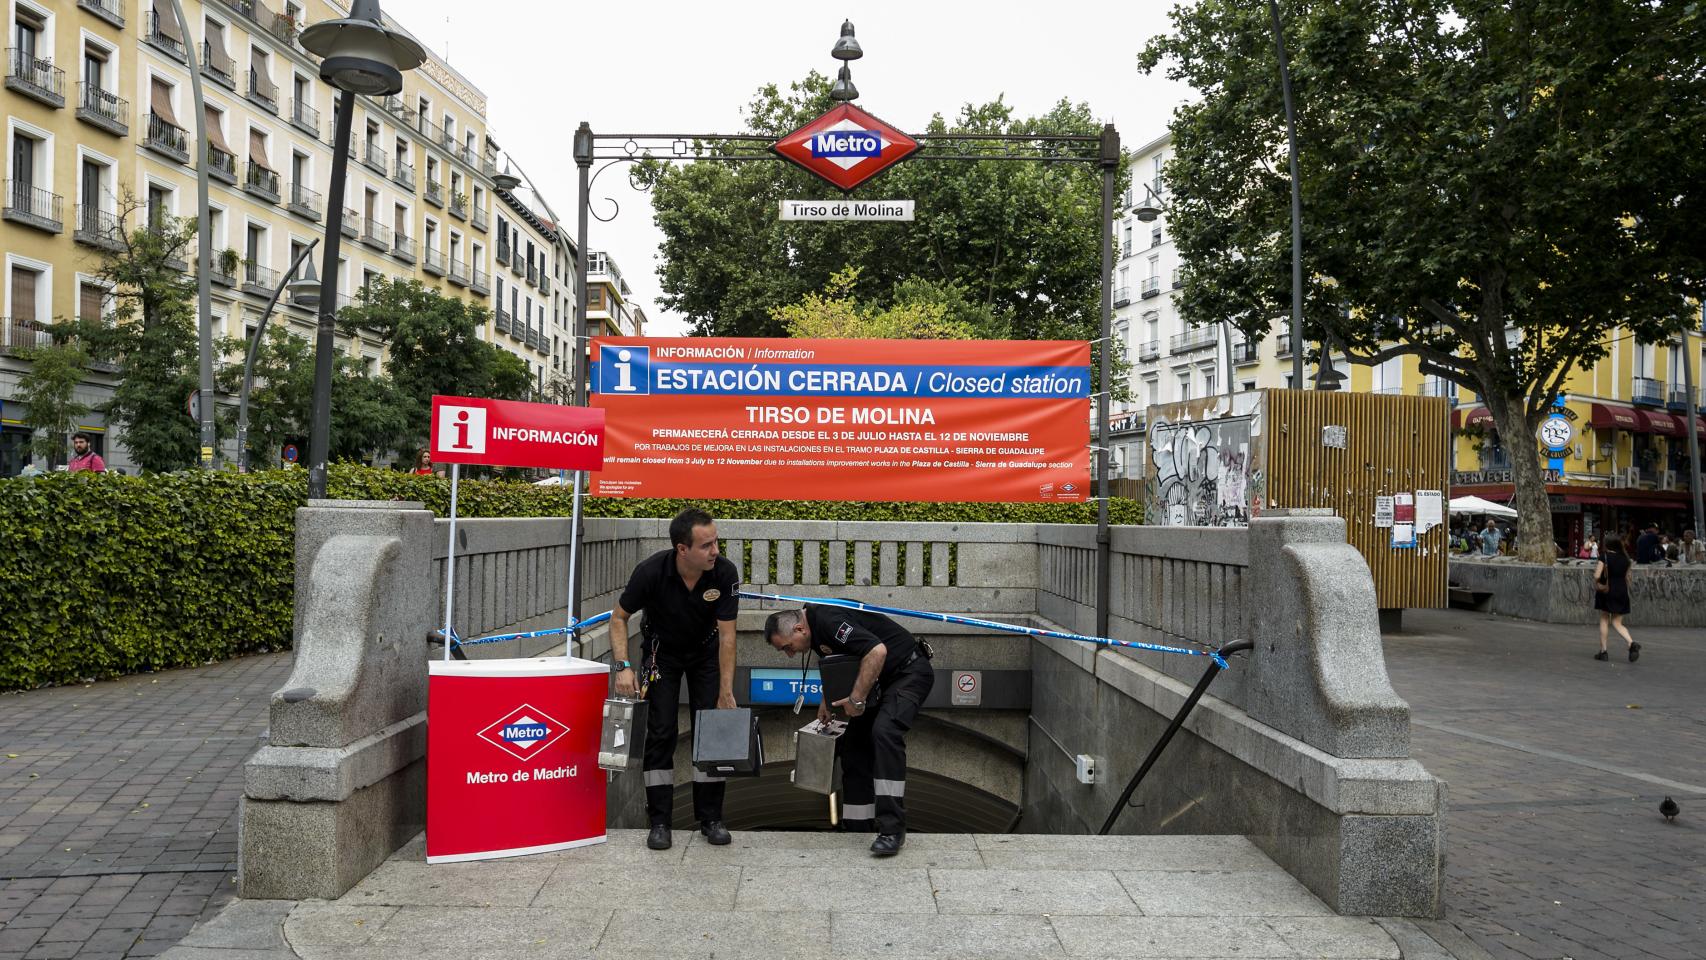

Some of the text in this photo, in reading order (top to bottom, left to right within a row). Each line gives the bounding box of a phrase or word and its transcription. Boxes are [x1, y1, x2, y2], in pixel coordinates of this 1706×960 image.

[817, 134, 877, 153] Metro
[791, 203, 903, 216] Tirso de Molina
[656, 345, 744, 359] INFORMACIÓN
[754, 348, 815, 360] Information
[657, 364, 781, 391] ESTACIÓN
[788, 370, 908, 392] CERRADA
[929, 371, 1006, 393] Closed
[1010, 373, 1082, 394] station
[746, 406, 936, 425] TIRSO DE MOLINA
[492, 427, 599, 447] INFORMACIÓN
[652, 428, 1029, 442] PERMANECERÁ CERRADA DESDE EL 3 DE JULIO HASTA EL 12 DE NOVIEMBRE
[634, 443, 651, 451] POR
[652, 443, 690, 452] TRABAJOS
[691, 444, 702, 452] DE
[703, 444, 735, 452] MEJORA
[763, 445, 822, 453] INSTALACIONES
[846, 446, 873, 454] TRAMO
[874, 446, 899, 454] PLAZA
[900, 446, 911, 454] DE
[912, 447, 950, 455] CASTILLA
[955, 447, 984, 455] SIERRA
[985, 447, 997, 455] DE
[998, 447, 1045, 455] GUADALUPE
[691, 457, 706, 466] July
[943, 460, 970, 468] Castilla
[975, 460, 997, 468] Sierra
[1008, 460, 1047, 470] Guadalupe
[506, 726, 544, 739] Metro
[466, 765, 578, 784] Metro de Madrid
